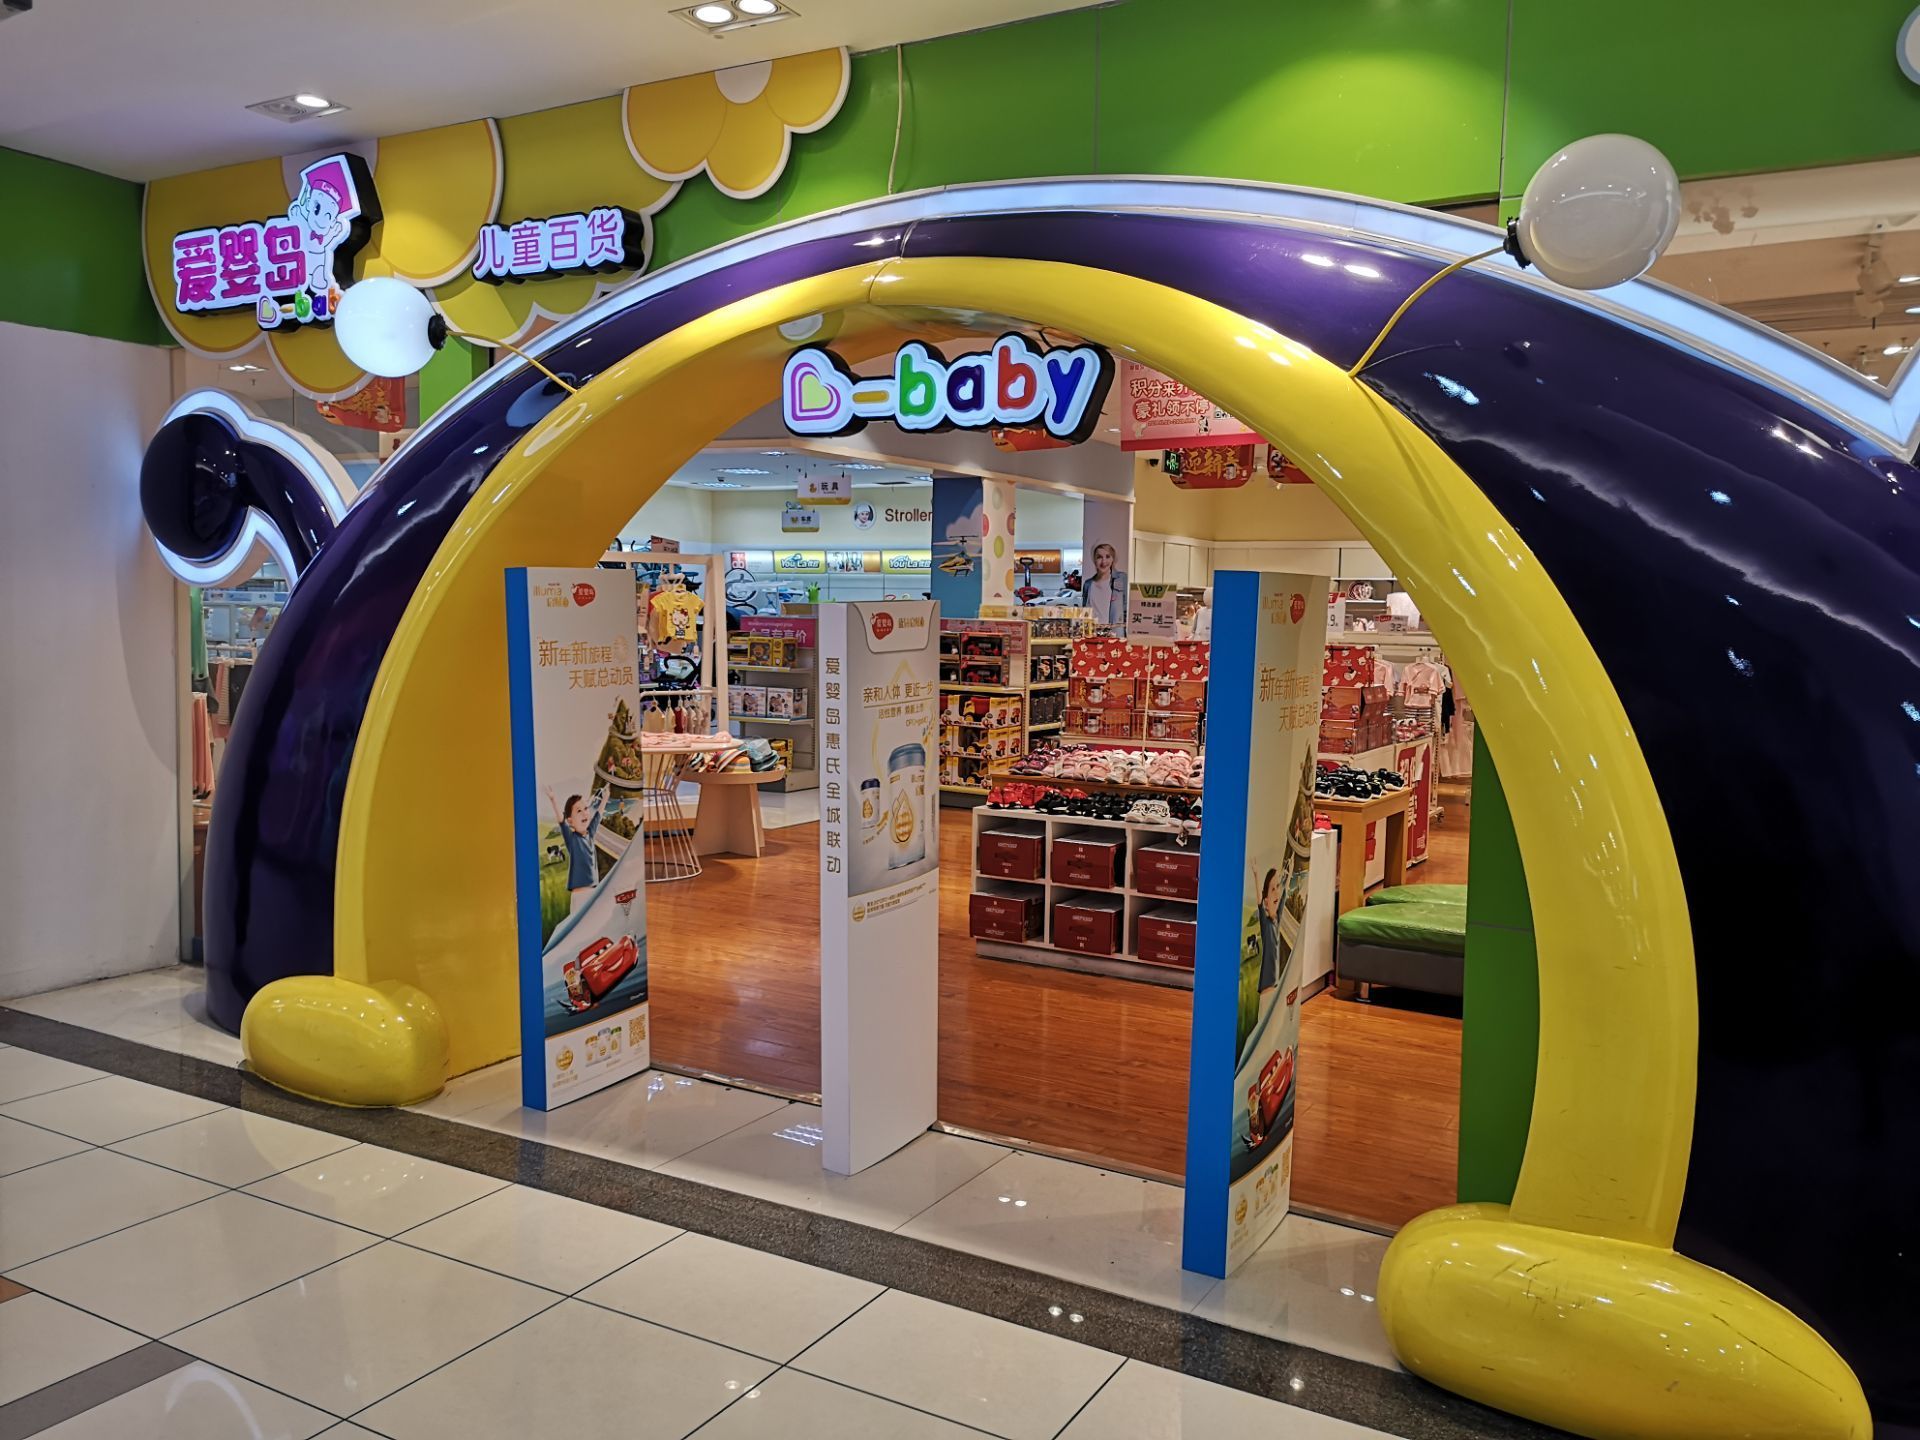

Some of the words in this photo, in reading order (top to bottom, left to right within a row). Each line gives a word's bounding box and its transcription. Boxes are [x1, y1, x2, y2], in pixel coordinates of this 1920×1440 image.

[476, 208, 623, 272] 儿童百货
[175, 225, 306, 303] 爱婴岛
[1135, 398, 1210, 420] 豪礼领不停
[1144, 585, 1163, 595] VIP
[1131, 612, 1174, 625] 买一送二
[539, 639, 613, 667] 新年新旅程
[568, 666, 633, 690] 天赋总动员
[826, 657, 841, 874] 爱婴岛惠氏全城联动
